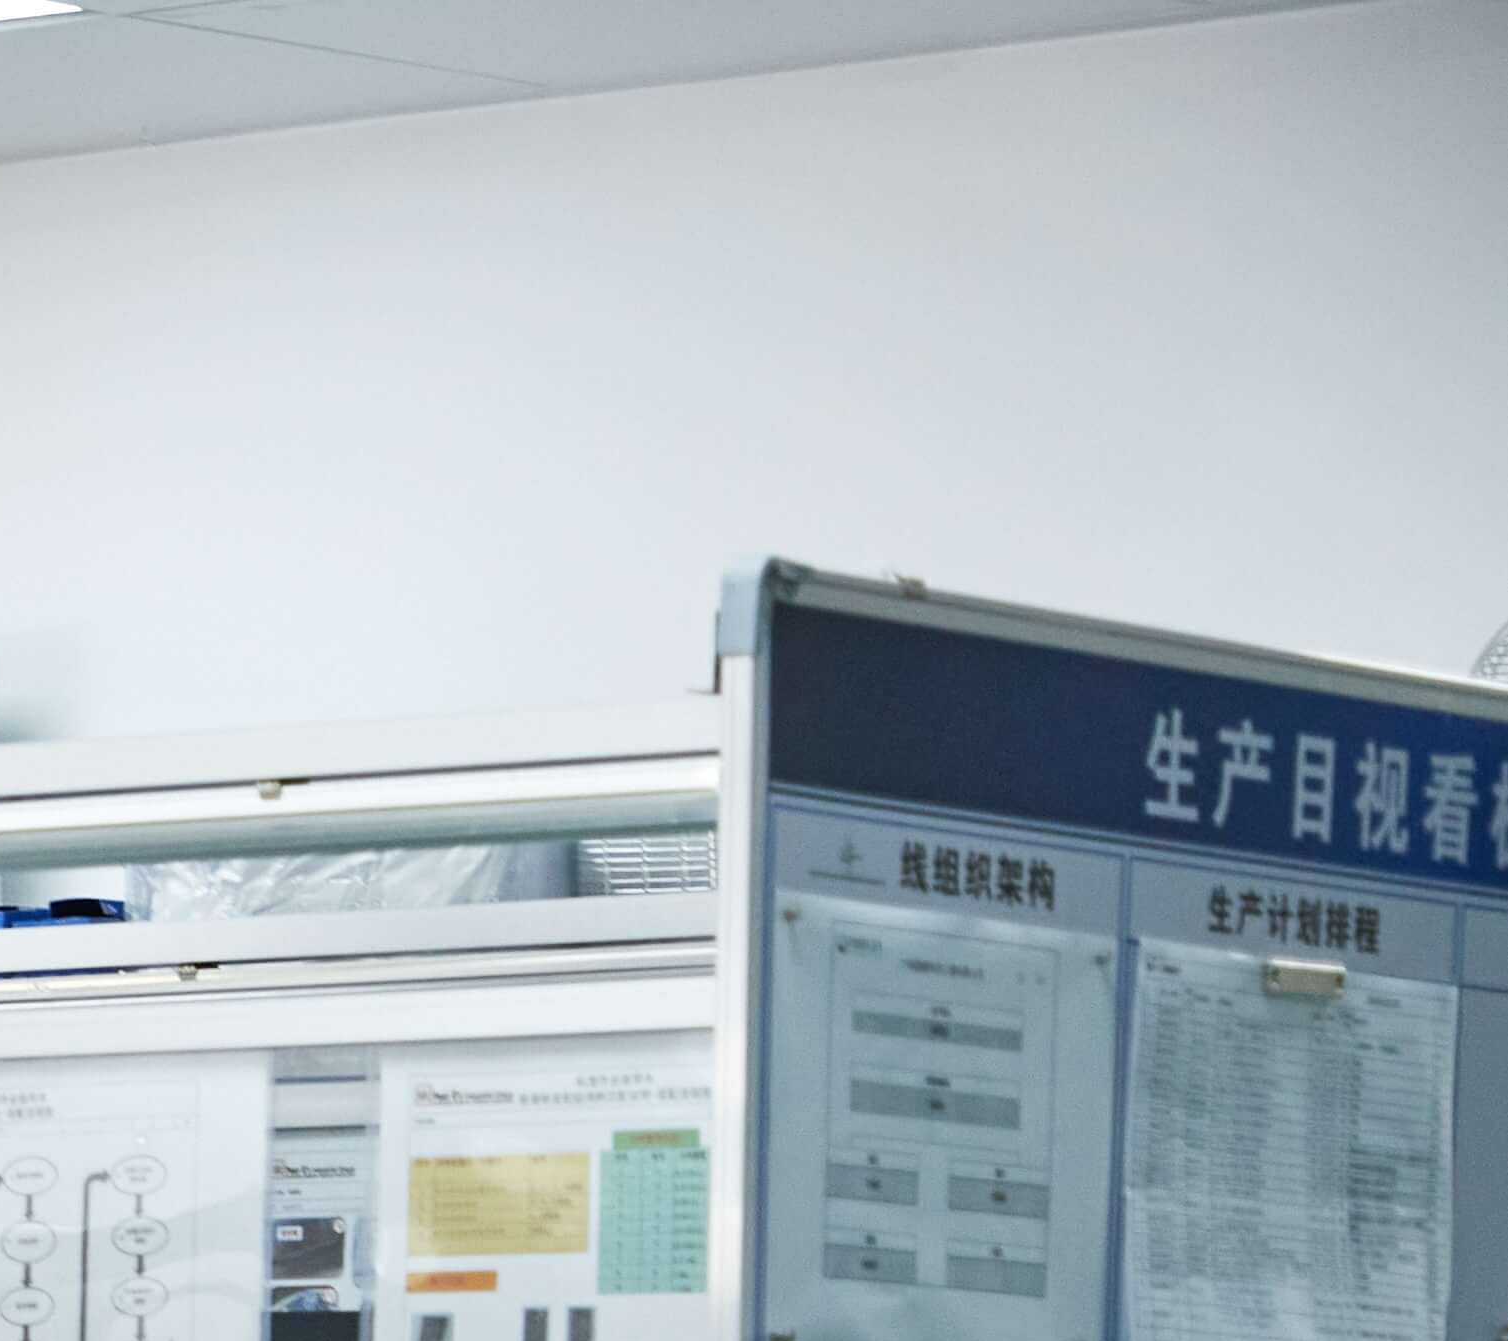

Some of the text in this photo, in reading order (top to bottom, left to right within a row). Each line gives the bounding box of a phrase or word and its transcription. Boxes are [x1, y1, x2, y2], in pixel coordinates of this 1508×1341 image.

[899, 840, 1056, 911] 线组织架构
[1208, 884, 1381, 956] 生产计划排程
